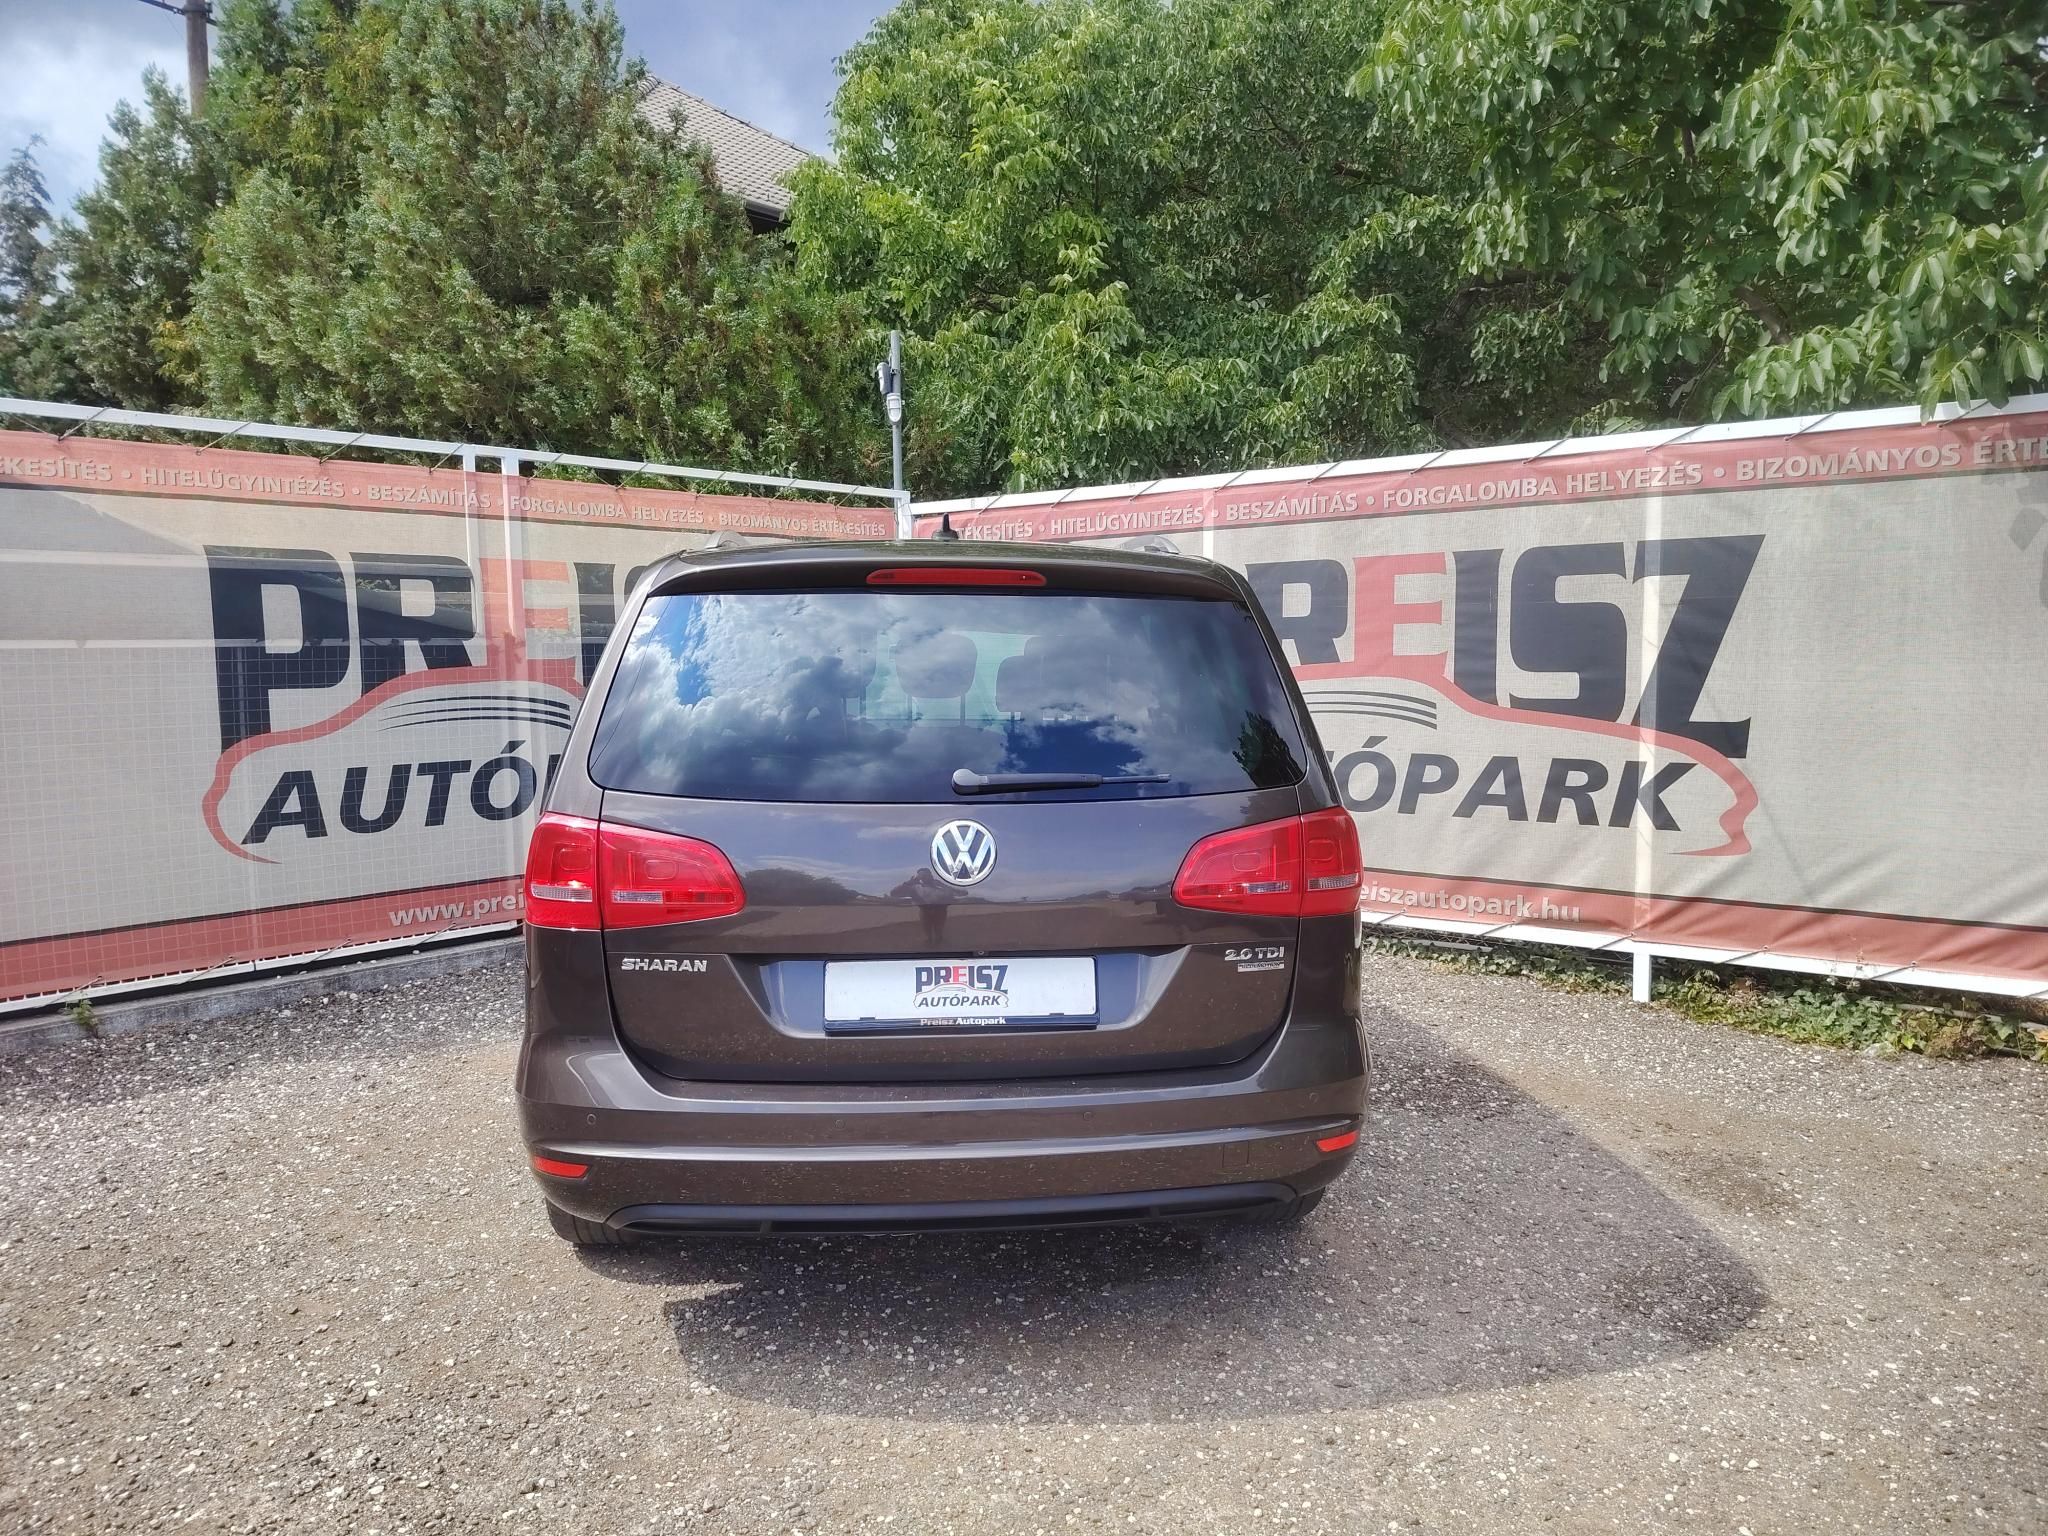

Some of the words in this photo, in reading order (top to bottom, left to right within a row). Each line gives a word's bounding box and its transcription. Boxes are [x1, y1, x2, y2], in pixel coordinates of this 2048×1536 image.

[142, 467, 345, 498] HITELÜGYINTÉZÉS
[367, 485, 492, 508] BESZÁMÍTÁS
[511, 496, 627, 519] FORGALOMBA
[632, 506, 704, 524] HELYEZÉS
[719, 512, 808, 532] BIZOMÁNYOS
[812, 517, 886, 536] ÉRTÉKESÍTÉS
[956, 519, 1034, 541] TÉKESÍTÉS
[1050, 504, 1204, 536] HITELÜGYINTÉZÉS
[1226, 490, 1359, 521] BESZÁMÍTÁS
[1383, 476, 1558, 509] FORGALOMBA
[1566, 460, 1703, 496] HELYEZÉS
[1736, 443, 1961, 481] BIZOMÁNYOS
[203, 545, 648, 754] PREI
[1245, 534, 1765, 759] REISZ
[241, 739, 561, 846] AUTÓ
[1326, 735, 1698, 832] ÓPARK
[389, 887, 525, 927] www.prei
[1360, 880, 1581, 923] eiszautopark.hu
[621, 958, 708, 972] SHARAN
[1255, 946, 1284, 959] TDI
[915, 964, 1009, 995] PREISZ
[918, 994, 1002, 1008] AUTÓPARK
[920, 1018, 954, 1026] Preisz
[955, 1016, 1007, 1026] Autopark
